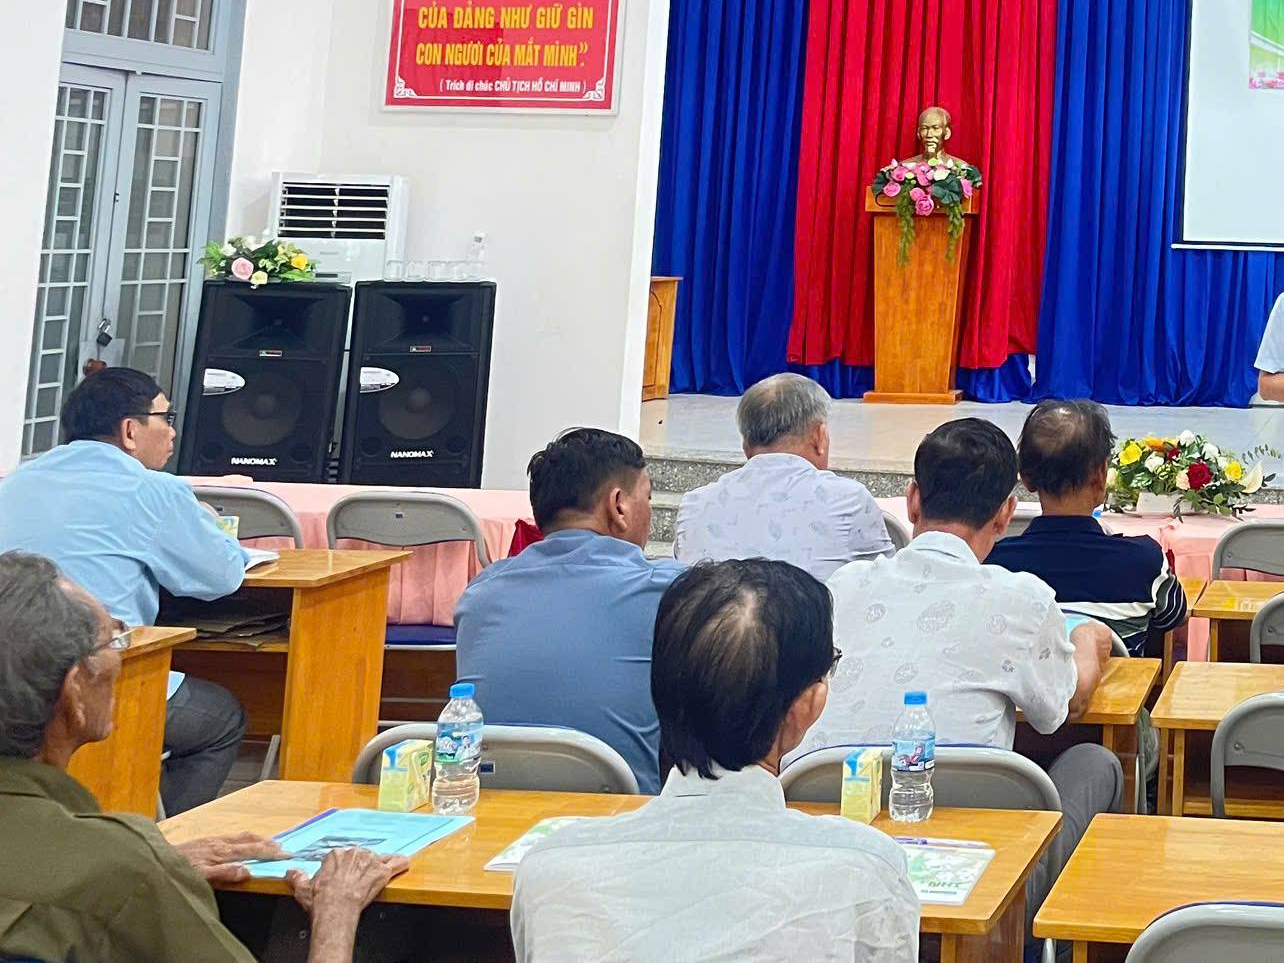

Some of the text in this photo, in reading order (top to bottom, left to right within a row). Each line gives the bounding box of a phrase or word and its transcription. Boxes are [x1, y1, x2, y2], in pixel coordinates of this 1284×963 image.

[418, 1, 593, 29] CỦA ĐẢNG NHƯ GIỮ GÌN
[416, 43, 442, 64] CON
[445, 41, 483, 65] NGƯỜI
[486, 38, 510, 65] CỦA
[514, 37, 540, 66] MẮT
[512, 81, 530, 93] TỊCH
[544, 78, 558, 92] CHÍ
[231, 457, 278, 466] NANOMAX
[390, 450, 434, 459] NANOMAX
